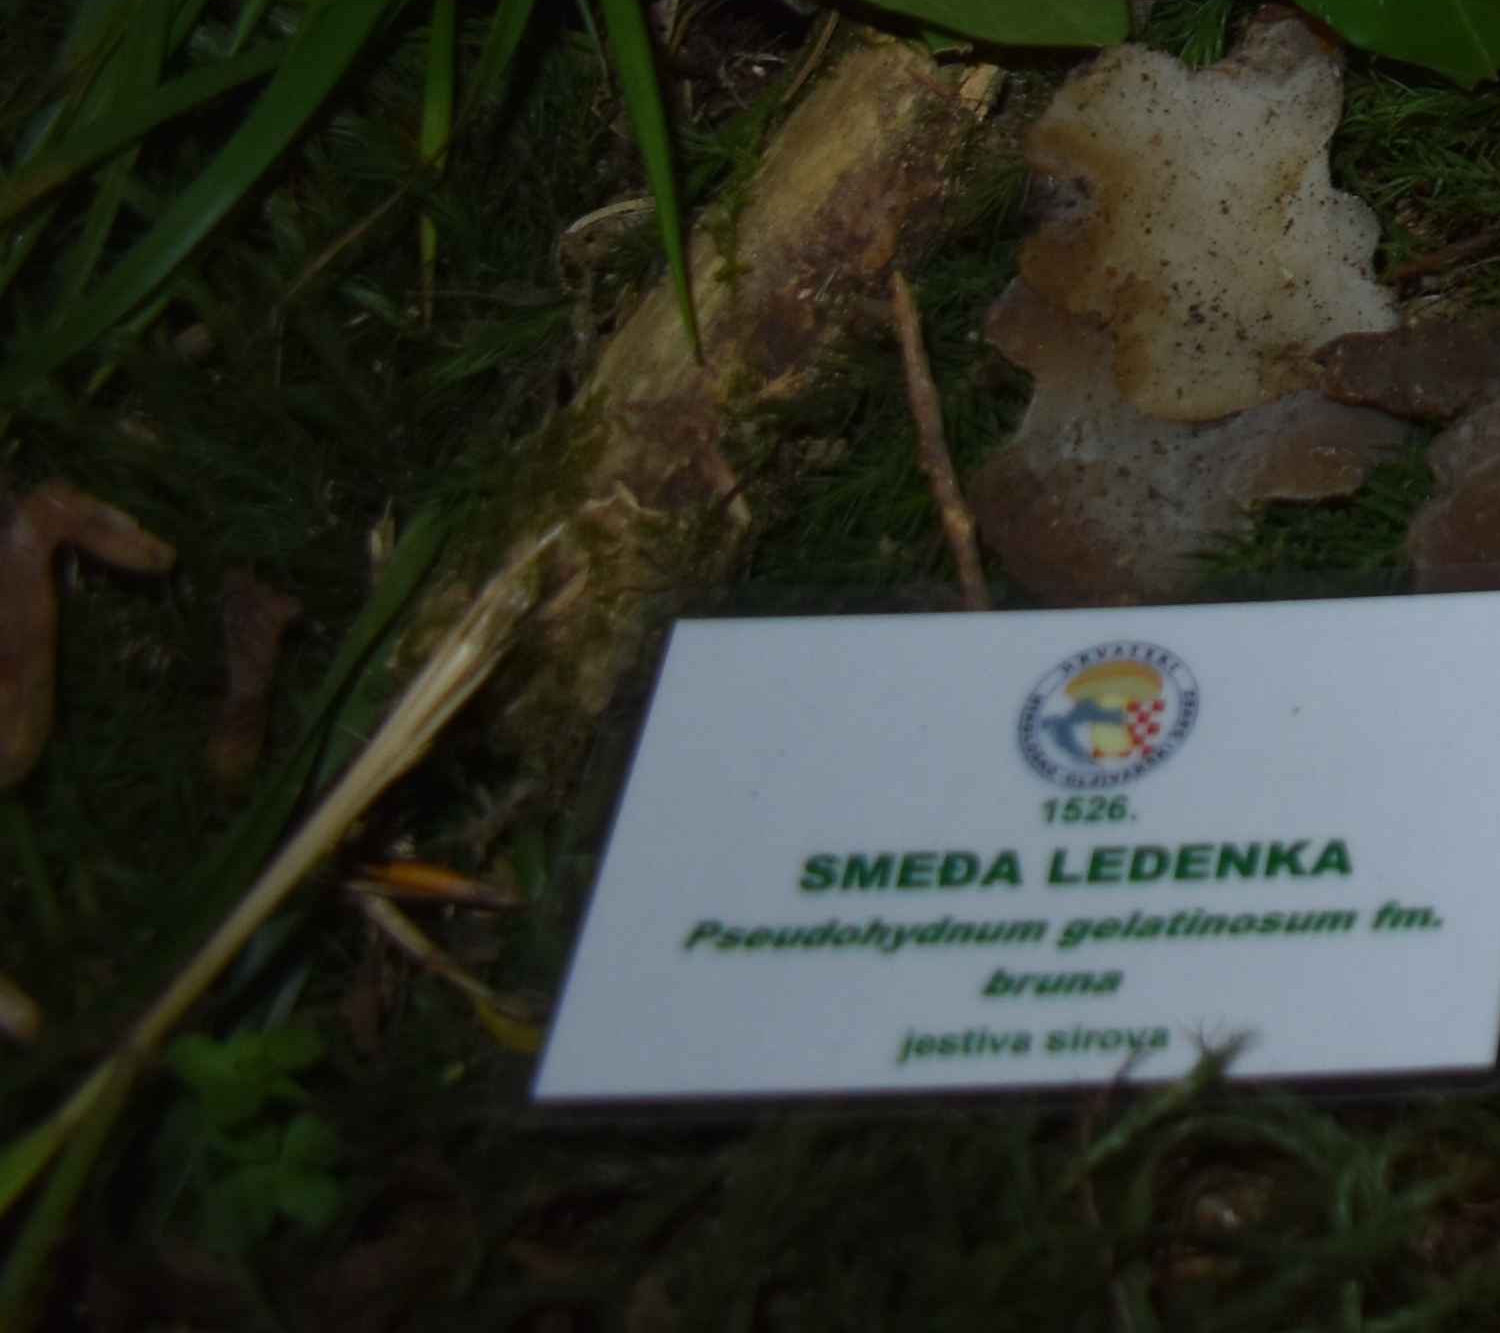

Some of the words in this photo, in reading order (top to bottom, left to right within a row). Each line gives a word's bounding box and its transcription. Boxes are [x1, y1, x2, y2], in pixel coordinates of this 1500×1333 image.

[1043, 796, 1139, 824] 1526.
[800, 851, 1022, 892] SMEĐA
[1048, 841, 1351, 886] LEDENKA
[684, 918, 1047, 953] Pseudohydnum
[1057, 910, 1356, 950] gelatinosum
[1371, 901, 1443, 931] fm.
[981, 969, 1122, 998] bruna
[897, 1031, 1031, 1064] jestiva
[1044, 1024, 1169, 1056] sirova
